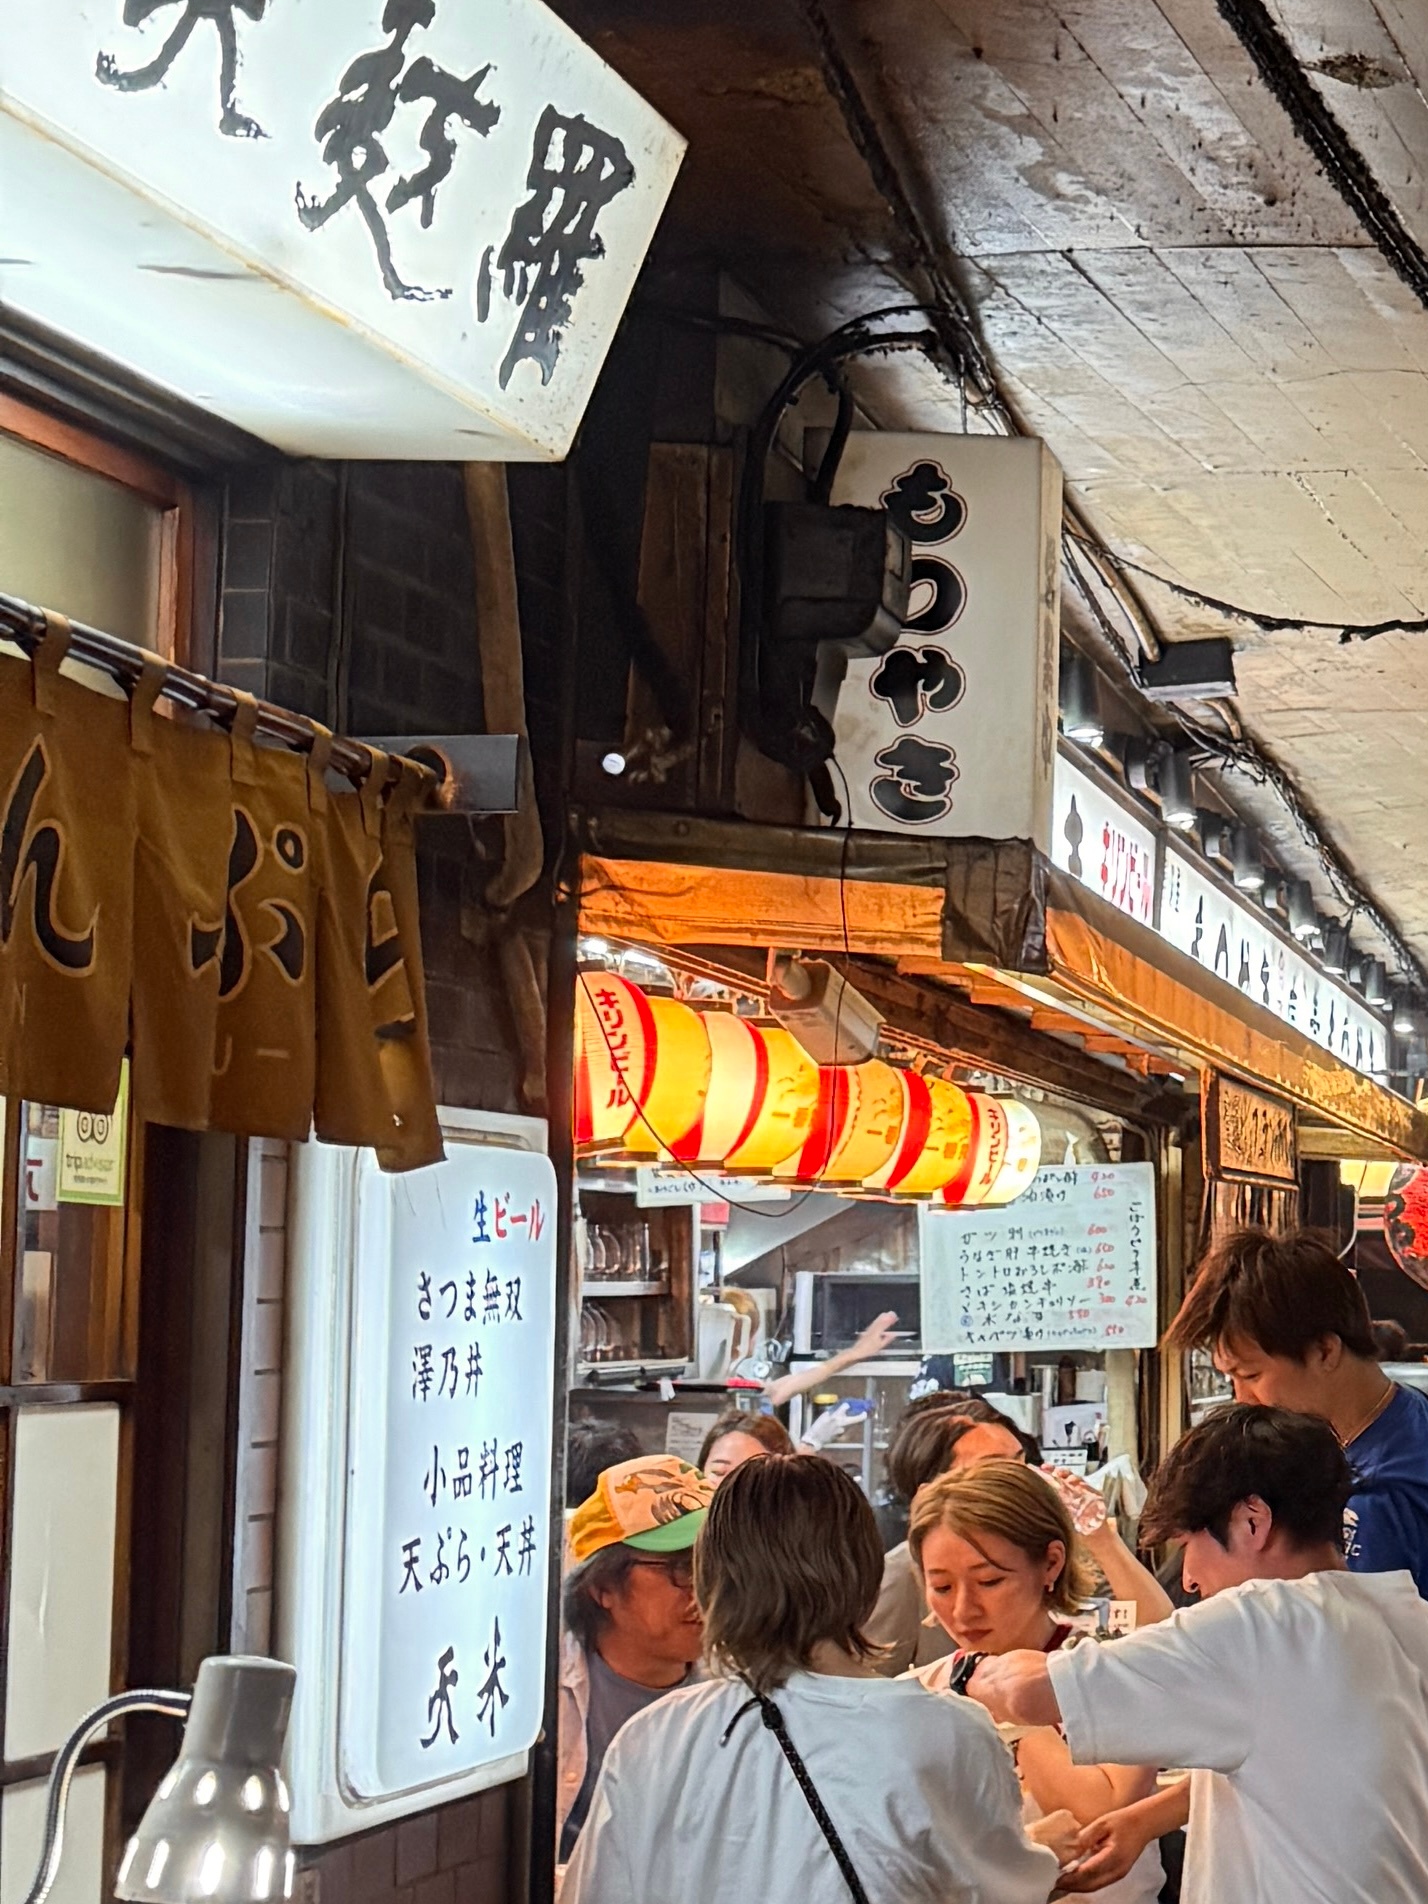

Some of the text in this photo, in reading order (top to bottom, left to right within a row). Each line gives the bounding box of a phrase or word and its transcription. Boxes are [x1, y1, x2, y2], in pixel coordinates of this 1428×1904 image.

[595, 988, 630, 1108] キリンビール
[472, 1190, 545, 1244] 生ビール
[416, 1268, 524, 1324] さつま無双
[411, 1343, 483, 1402] 澤乃井
[423, 1437, 524, 1507] 小品料理
[399, 1521, 538, 1595] 天ぷら・天丼
